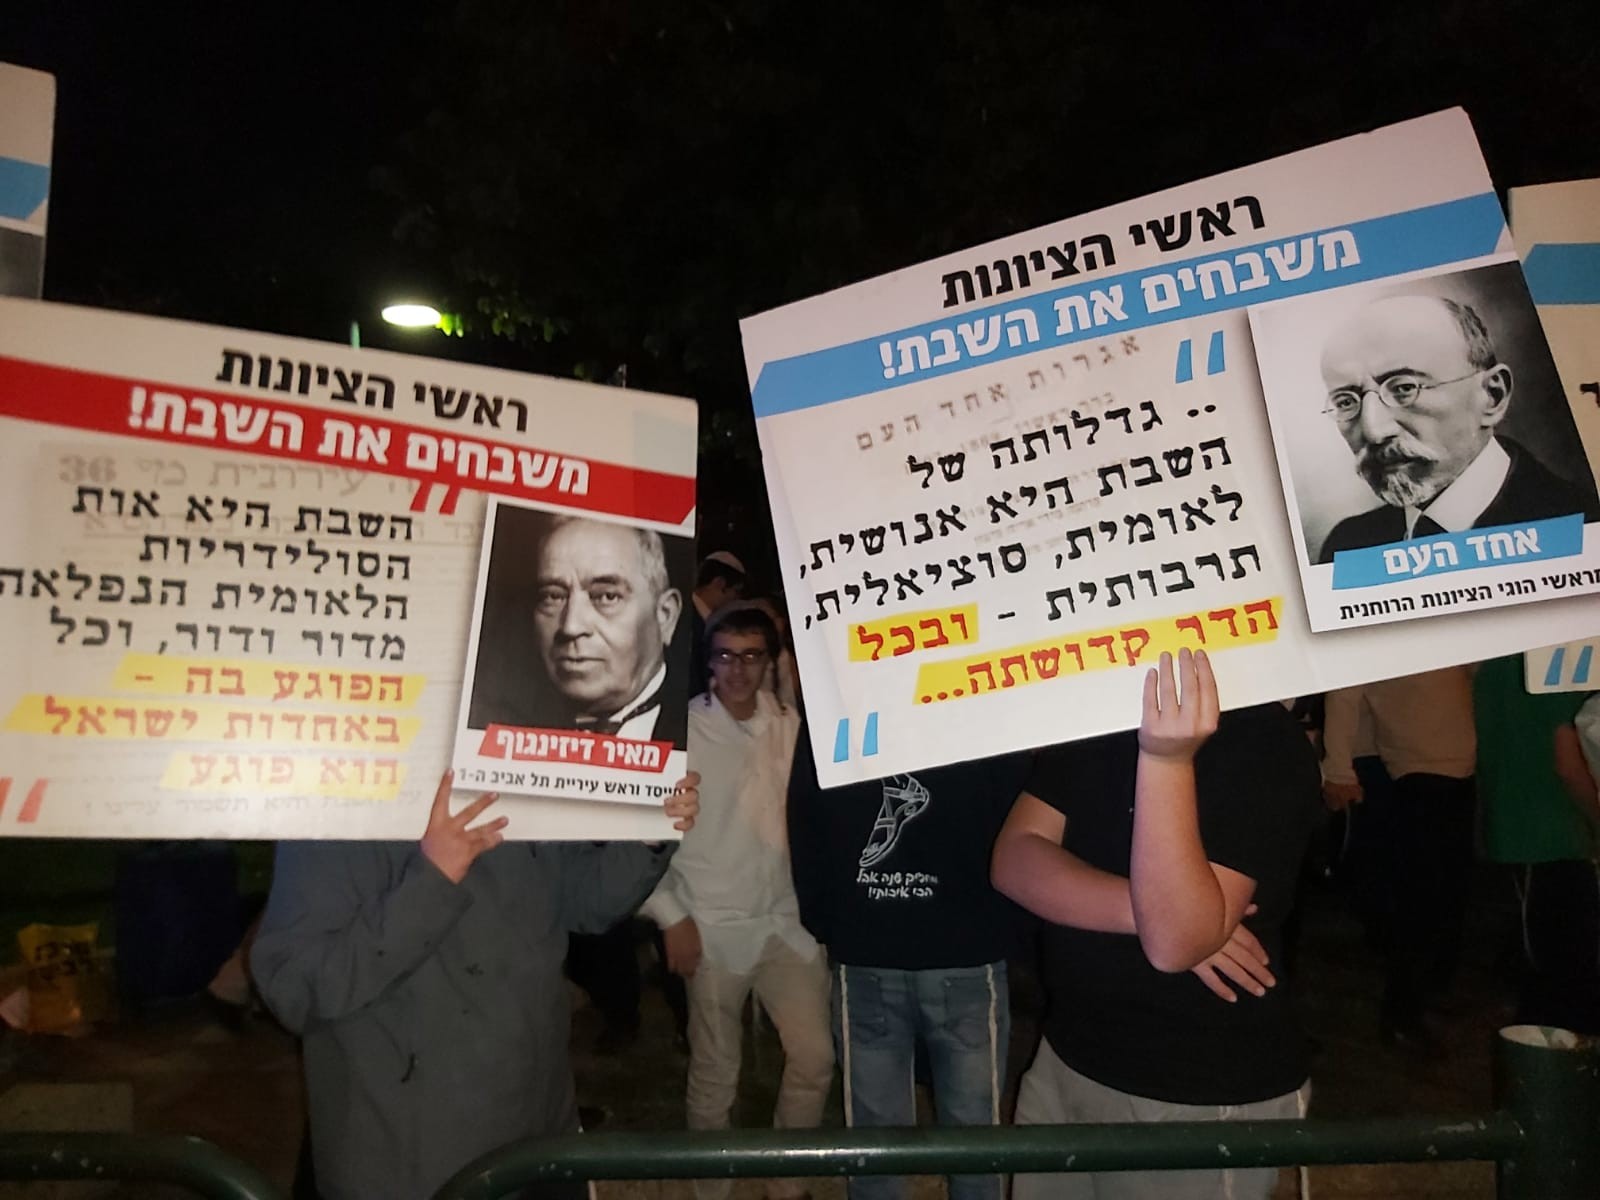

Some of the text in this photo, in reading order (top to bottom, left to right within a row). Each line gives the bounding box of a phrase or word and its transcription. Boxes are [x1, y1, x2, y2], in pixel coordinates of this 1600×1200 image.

[941, 195, 1265, 308] ראשי הציונות
[879, 229, 1361, 379] משבחים את השבת!
[1026, 333, 1141, 391] אגרות
[216, 347, 528, 434] ראשי הציונות
[939, 382, 1007, 417] אחד
[128, 386, 590, 494] משבחים את השבת!
[856, 412, 921, 451] העם
[989, 400, 1163, 469] גדלותה
[907, 454, 966, 488] של
[1097, 437, 1232, 497] השבת
[72, 485, 160, 518] אות
[185, 495, 270, 528] היא
[294, 505, 412, 541] השבת
[986, 477, 1074, 523] היא
[800, 505, 967, 579] אנושית,
[1055, 484, 1243, 569] לאומית,
[139, 535, 411, 581] הסולידריות
[1383, 527, 1542, 576] אחד העם
[0, 562, 408, 620] הלאומית הנפלאה
[805, 542, 1027, 630] סוציאלית,
[1046, 545, 1261, 621] תרבותית
[1420, 584, 1493, 609] הציונות
[1498, 577, 1537, 597] הוגי
[1340, 596, 1415, 620] הרוחנית
[50, 607, 407, 661] מדור ודור, וכל
[857, 612, 969, 661] ובכל
[920, 599, 1279, 704] הדר קדושתה...
[185, 666, 246, 696] בה
[272, 670, 404, 703] הפוגע
[44, 695, 401, 744] באחדות ישראל
[188, 756, 294, 787] פוגע
[319, 757, 399, 786] הוא
[496, 729, 660, 768] מאיר דיזינגוף
[490, 771, 525, 786] אביב
[530, 772, 550, 788] תל
[554, 778, 599, 793] עיריית
[605, 780, 640, 796] וראש
